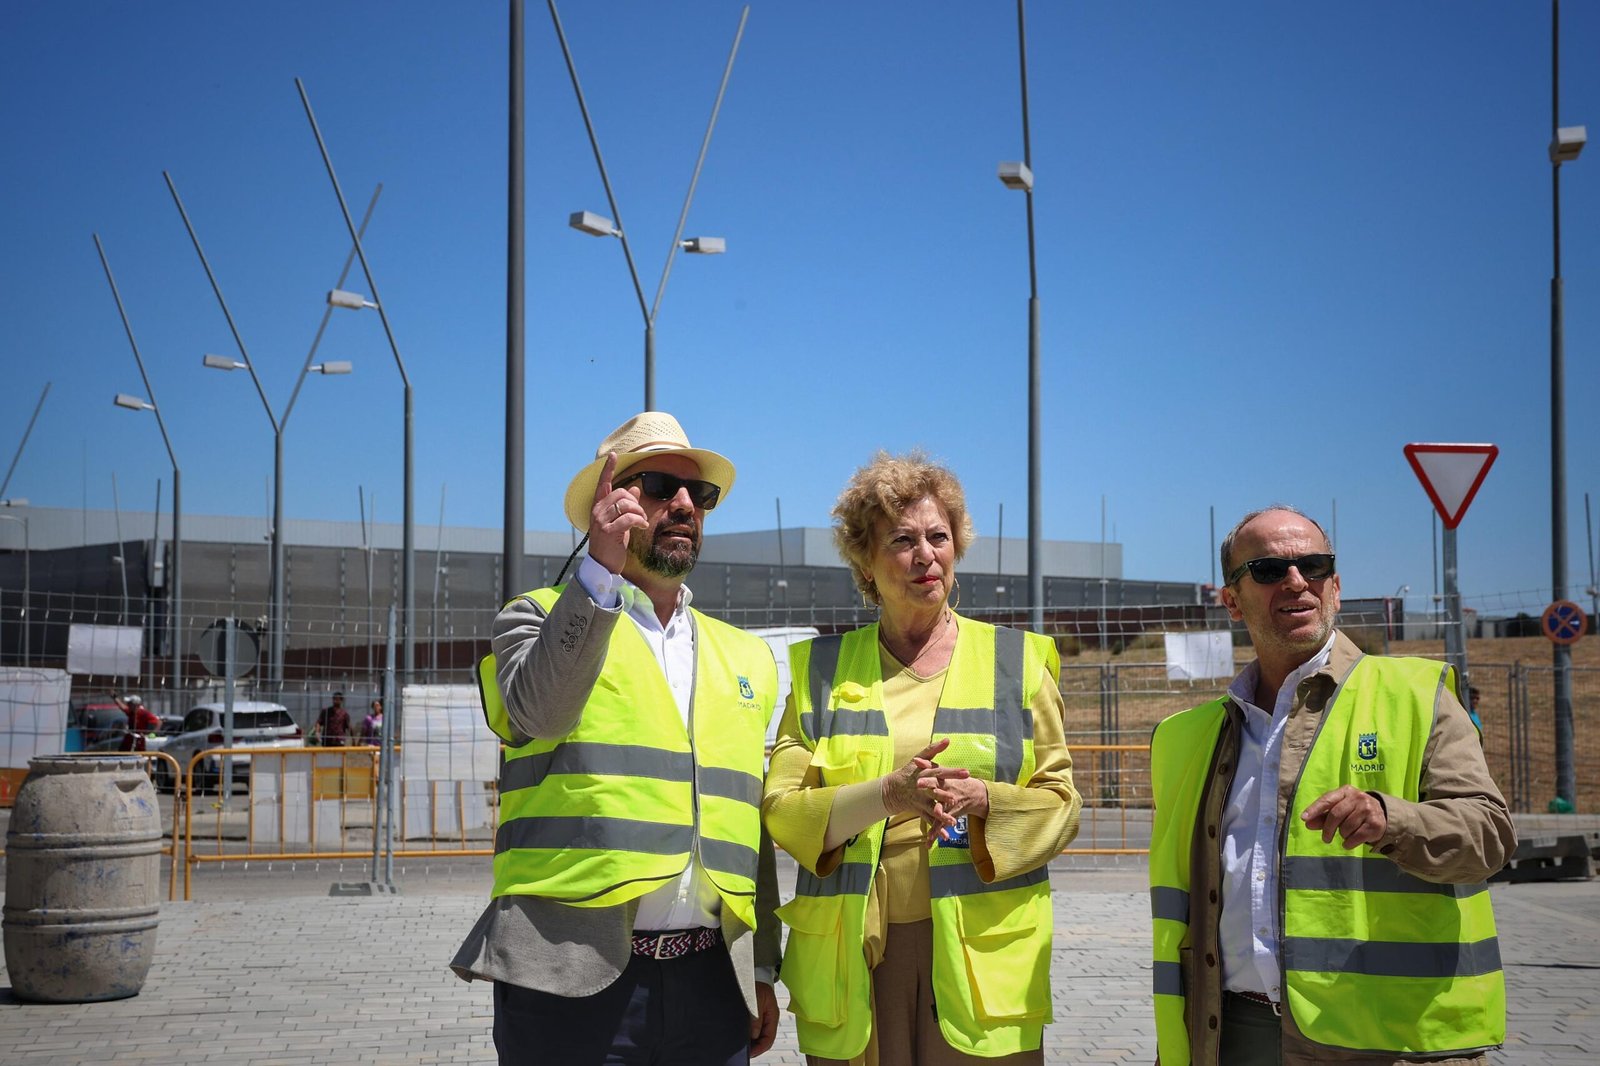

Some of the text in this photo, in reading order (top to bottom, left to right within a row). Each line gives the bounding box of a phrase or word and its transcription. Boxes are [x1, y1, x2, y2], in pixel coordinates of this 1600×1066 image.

[737, 701, 762, 711] MADRID
[1350, 763, 1385, 772] MADRID
[949, 837, 968, 845] MADR
